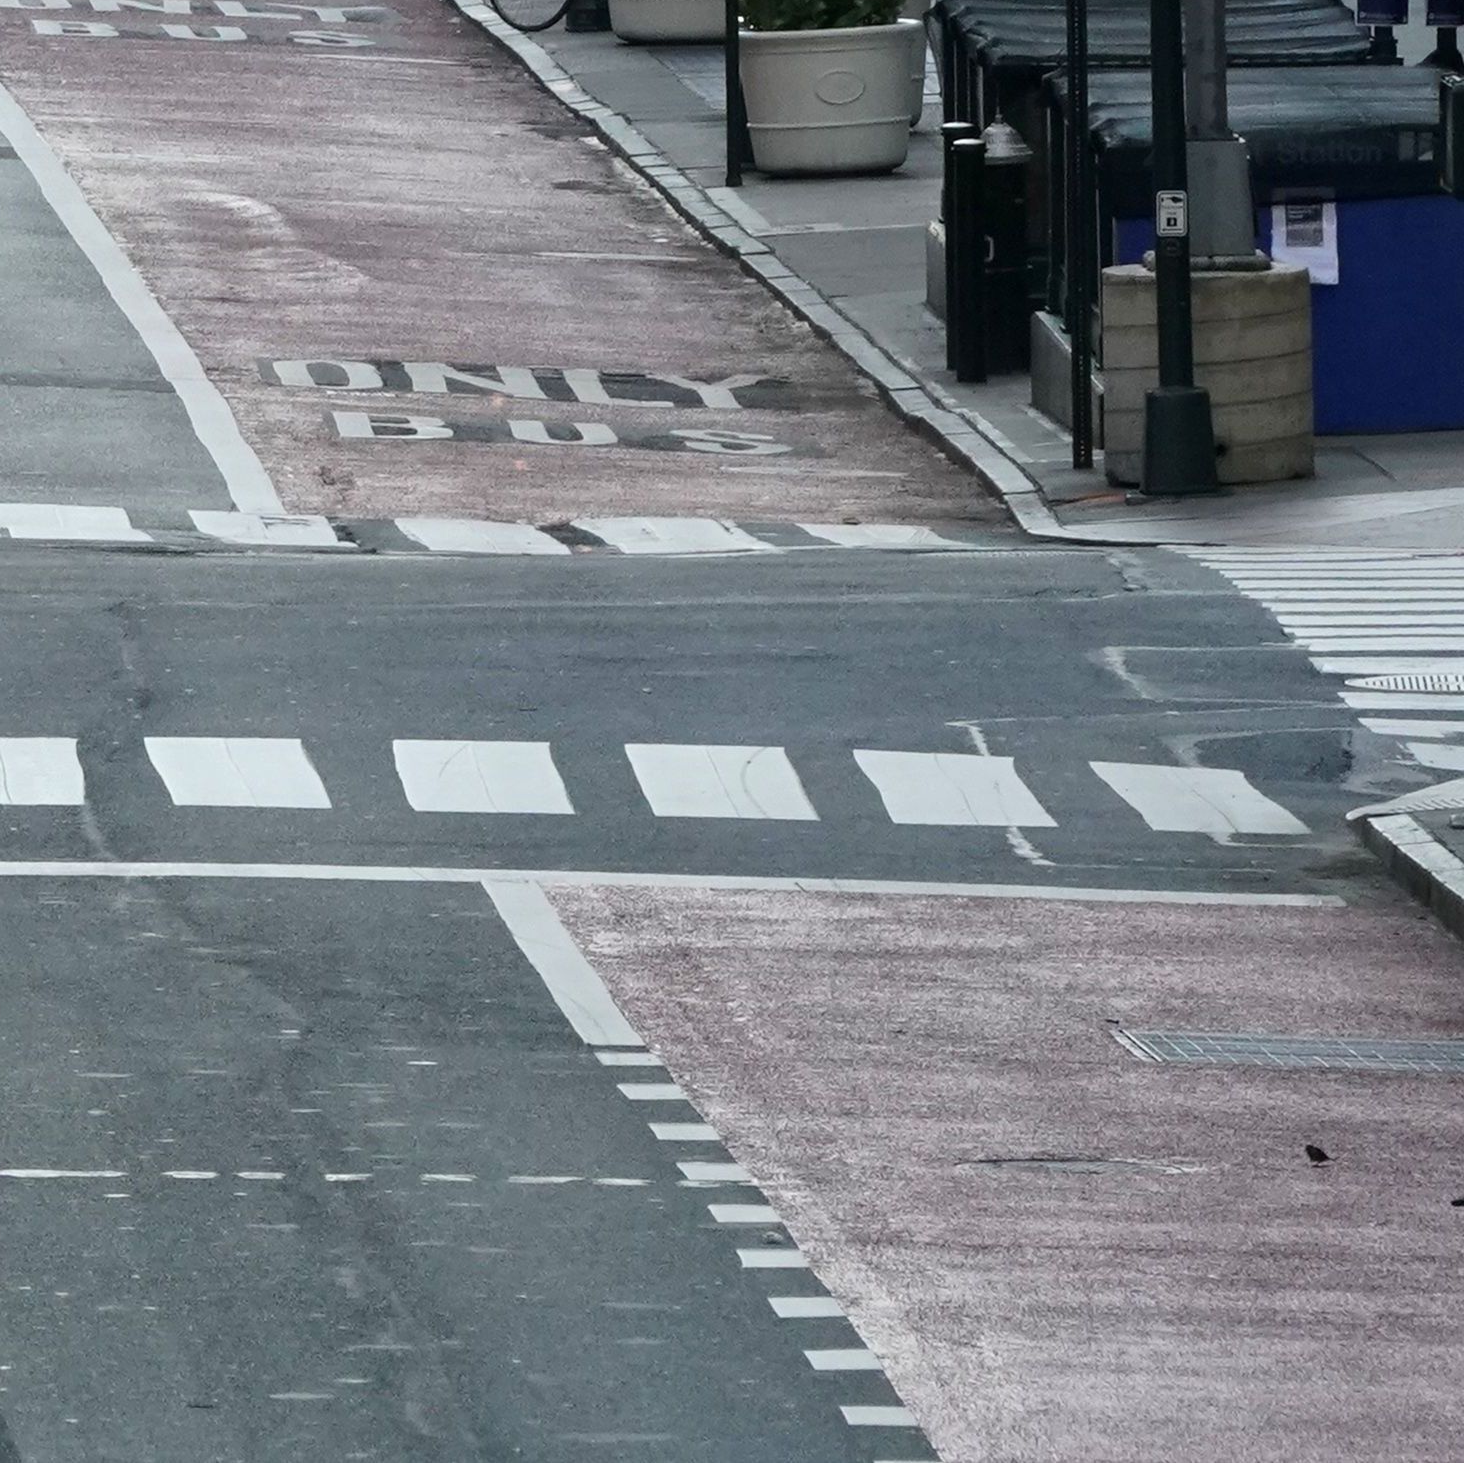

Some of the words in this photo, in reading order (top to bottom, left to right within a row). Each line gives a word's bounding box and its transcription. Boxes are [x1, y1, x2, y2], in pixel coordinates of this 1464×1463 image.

[30, 18, 377, 48] BUS
[272, 360, 787, 409] ONLY
[330, 410, 794, 456] BUS
